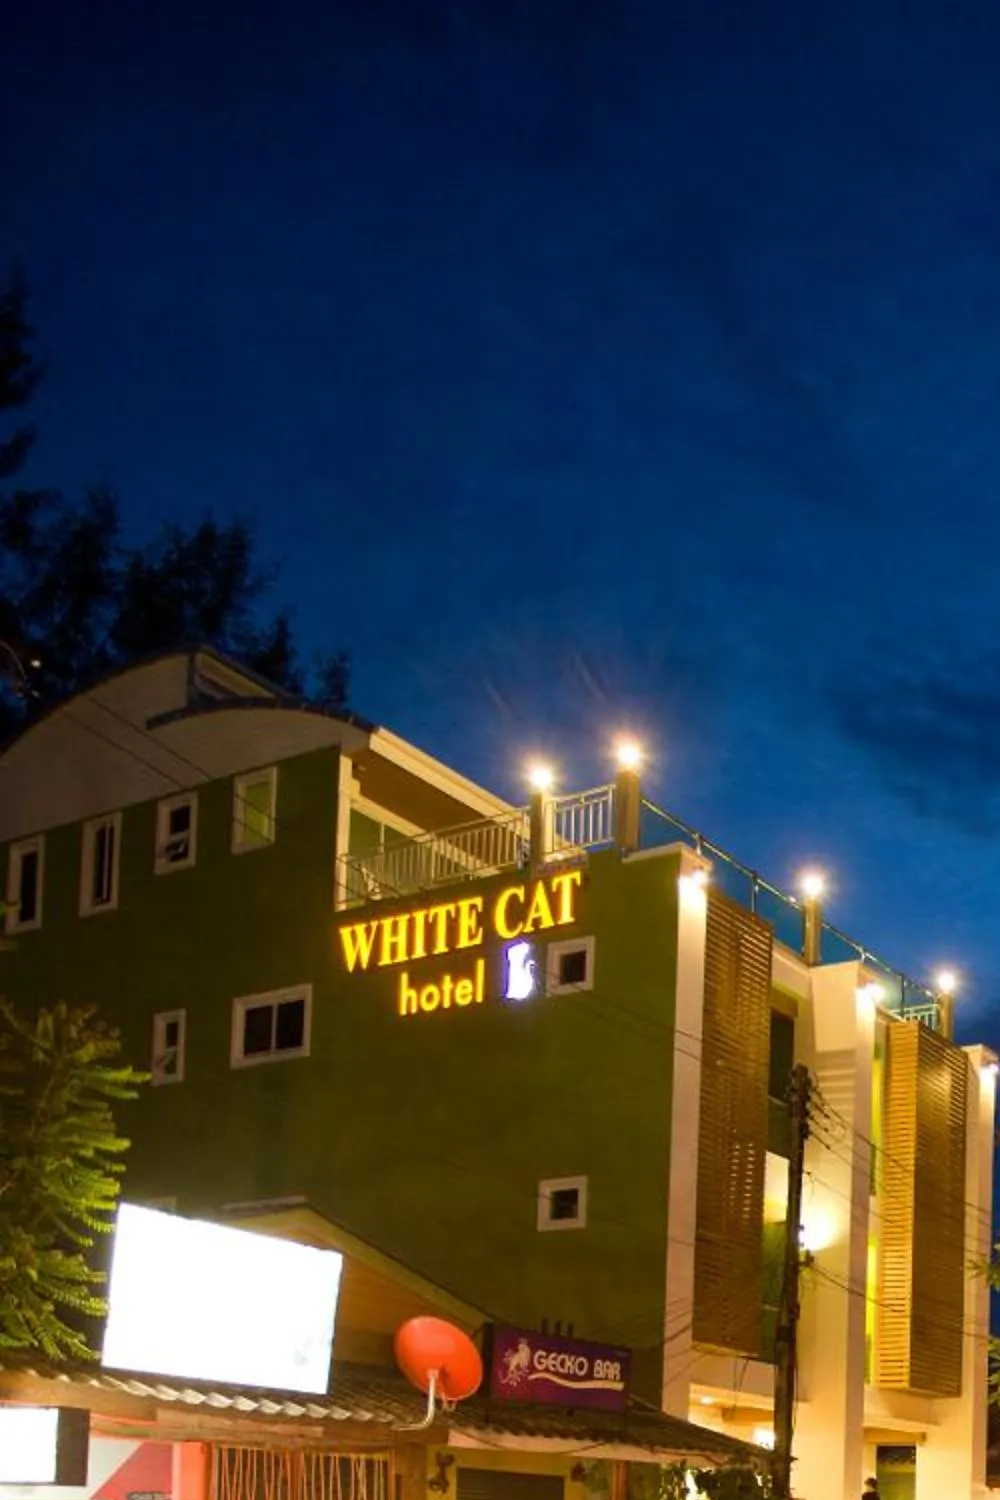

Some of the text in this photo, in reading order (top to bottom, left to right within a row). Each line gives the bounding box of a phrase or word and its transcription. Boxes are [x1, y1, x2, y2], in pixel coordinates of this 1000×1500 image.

[339, 871, 582, 972] WHITE CAT
[399, 959, 485, 1016] hotel
[533, 1350, 621, 1380] GECKO BAR
